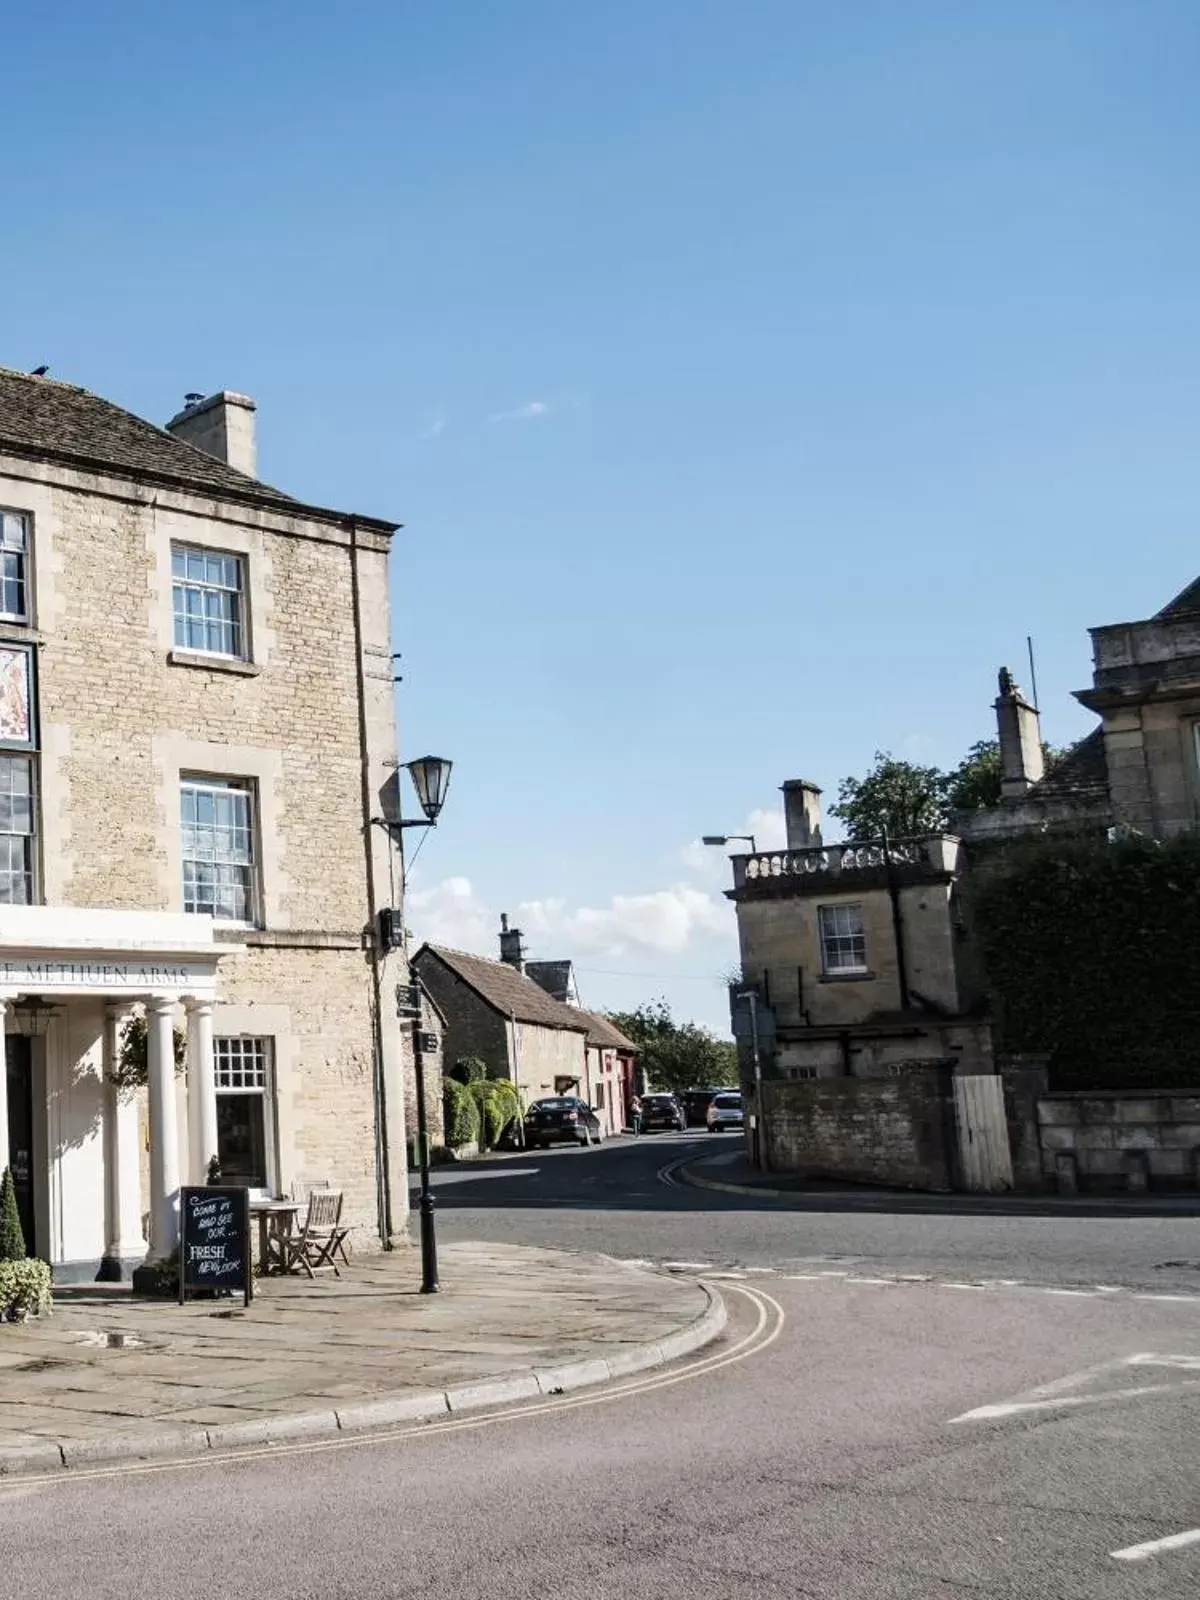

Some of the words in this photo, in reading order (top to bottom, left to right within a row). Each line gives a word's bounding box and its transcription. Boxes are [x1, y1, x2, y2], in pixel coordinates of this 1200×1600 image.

[26, 963, 128, 984] METHUEN
[138, 967, 188, 984] ARMS
[190, 1245, 225, 1260] FRESH
[198, 1260, 219, 1275] NEW
